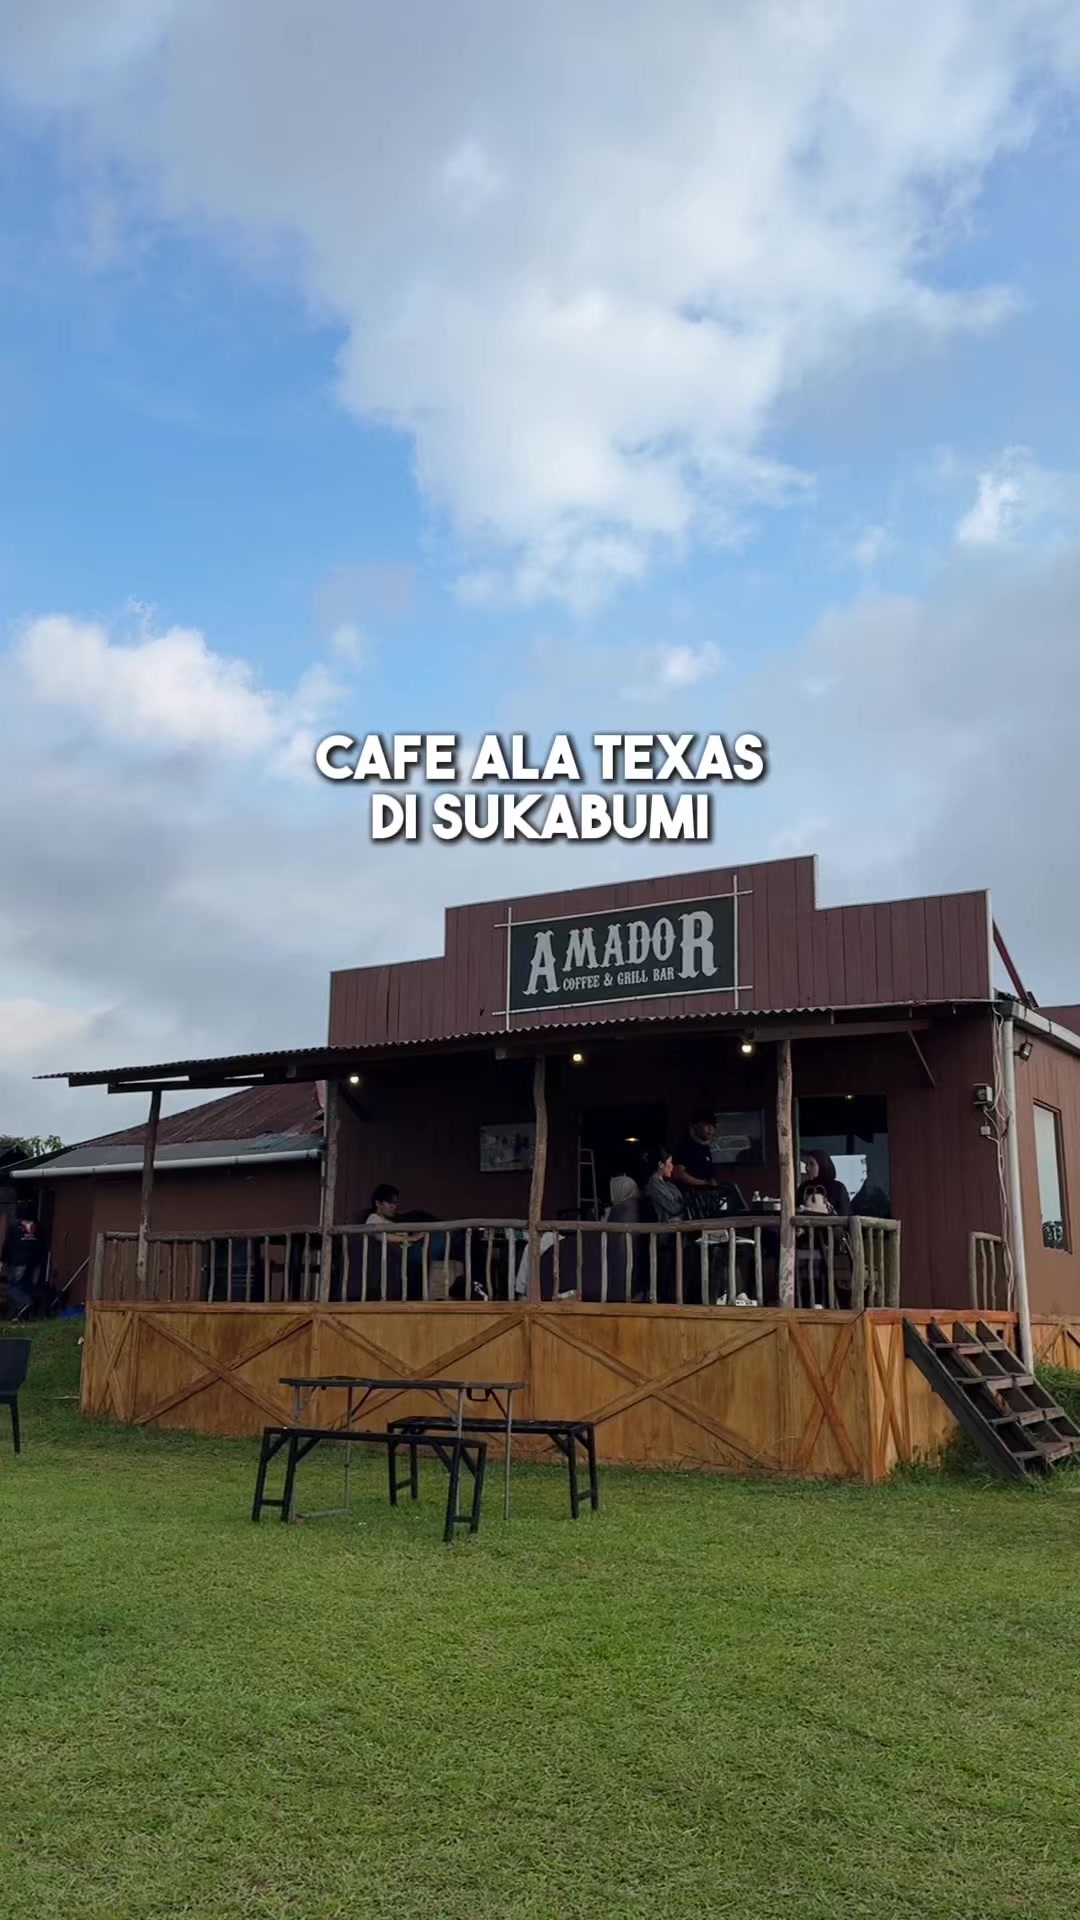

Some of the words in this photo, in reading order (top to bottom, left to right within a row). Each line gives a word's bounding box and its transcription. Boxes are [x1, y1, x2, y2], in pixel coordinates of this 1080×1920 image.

[523, 911, 718, 995] AMADOR
[563, 976, 601, 991] COFFEE
[603, 974, 614, 986] &
[617, 970, 649, 985] GRILL
[653, 966, 675, 981] BAR
